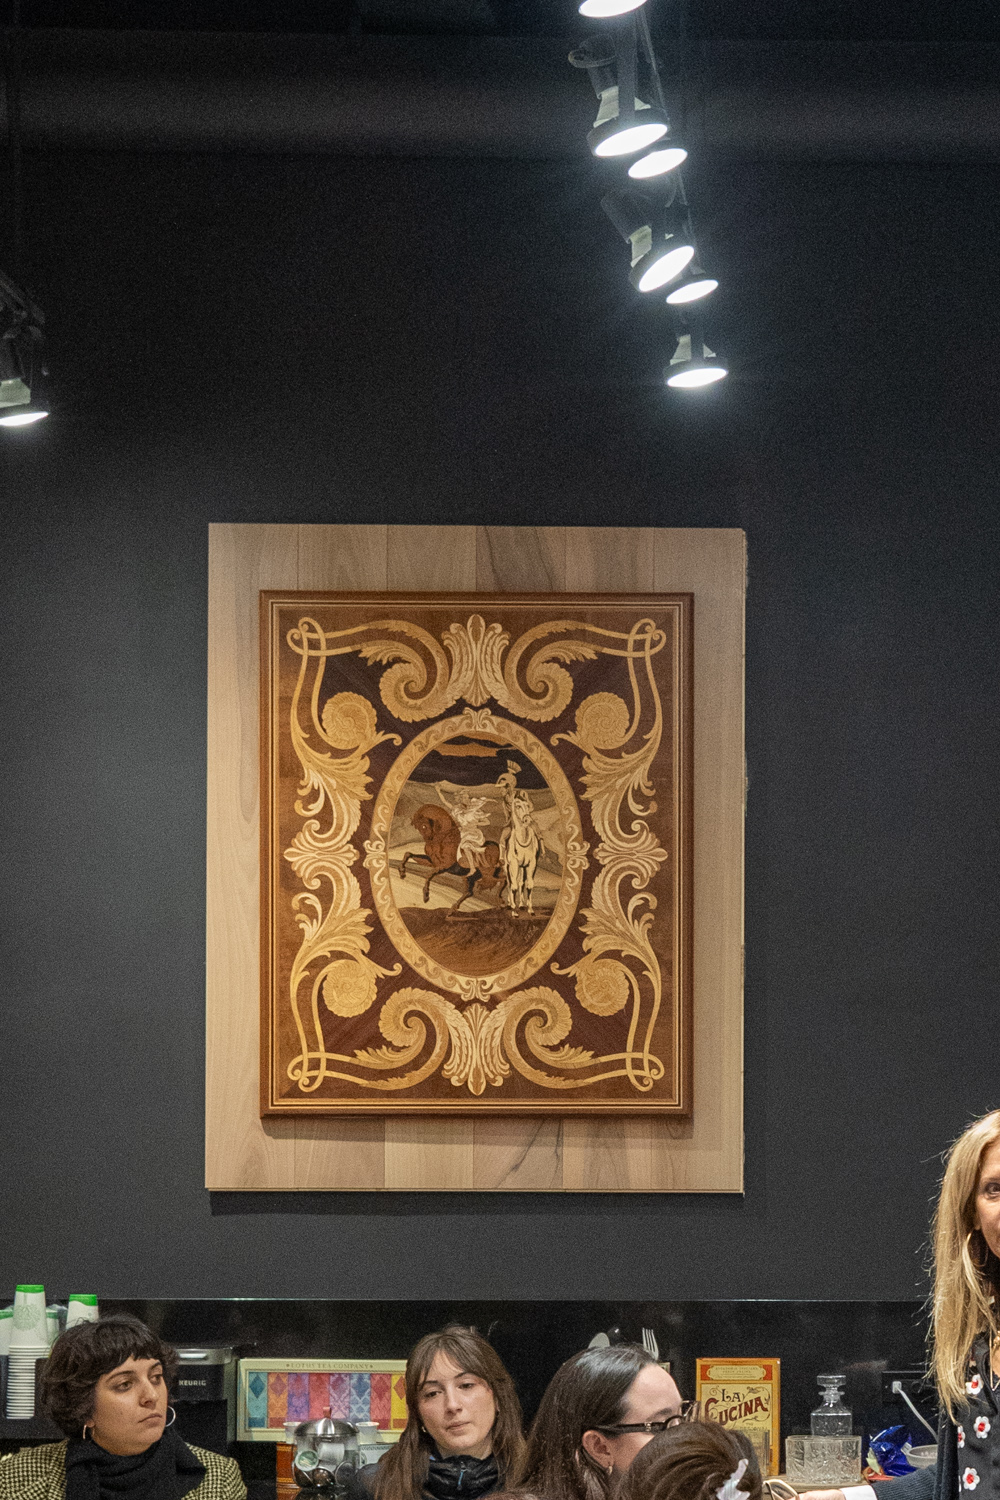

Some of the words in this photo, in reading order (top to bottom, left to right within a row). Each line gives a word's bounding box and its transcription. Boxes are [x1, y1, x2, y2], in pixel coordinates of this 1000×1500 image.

[333, 1362, 369, 1370] COMPANY
[721, 1388, 742, 1402] LA
[704, 1396, 769, 1426] CUCINA
